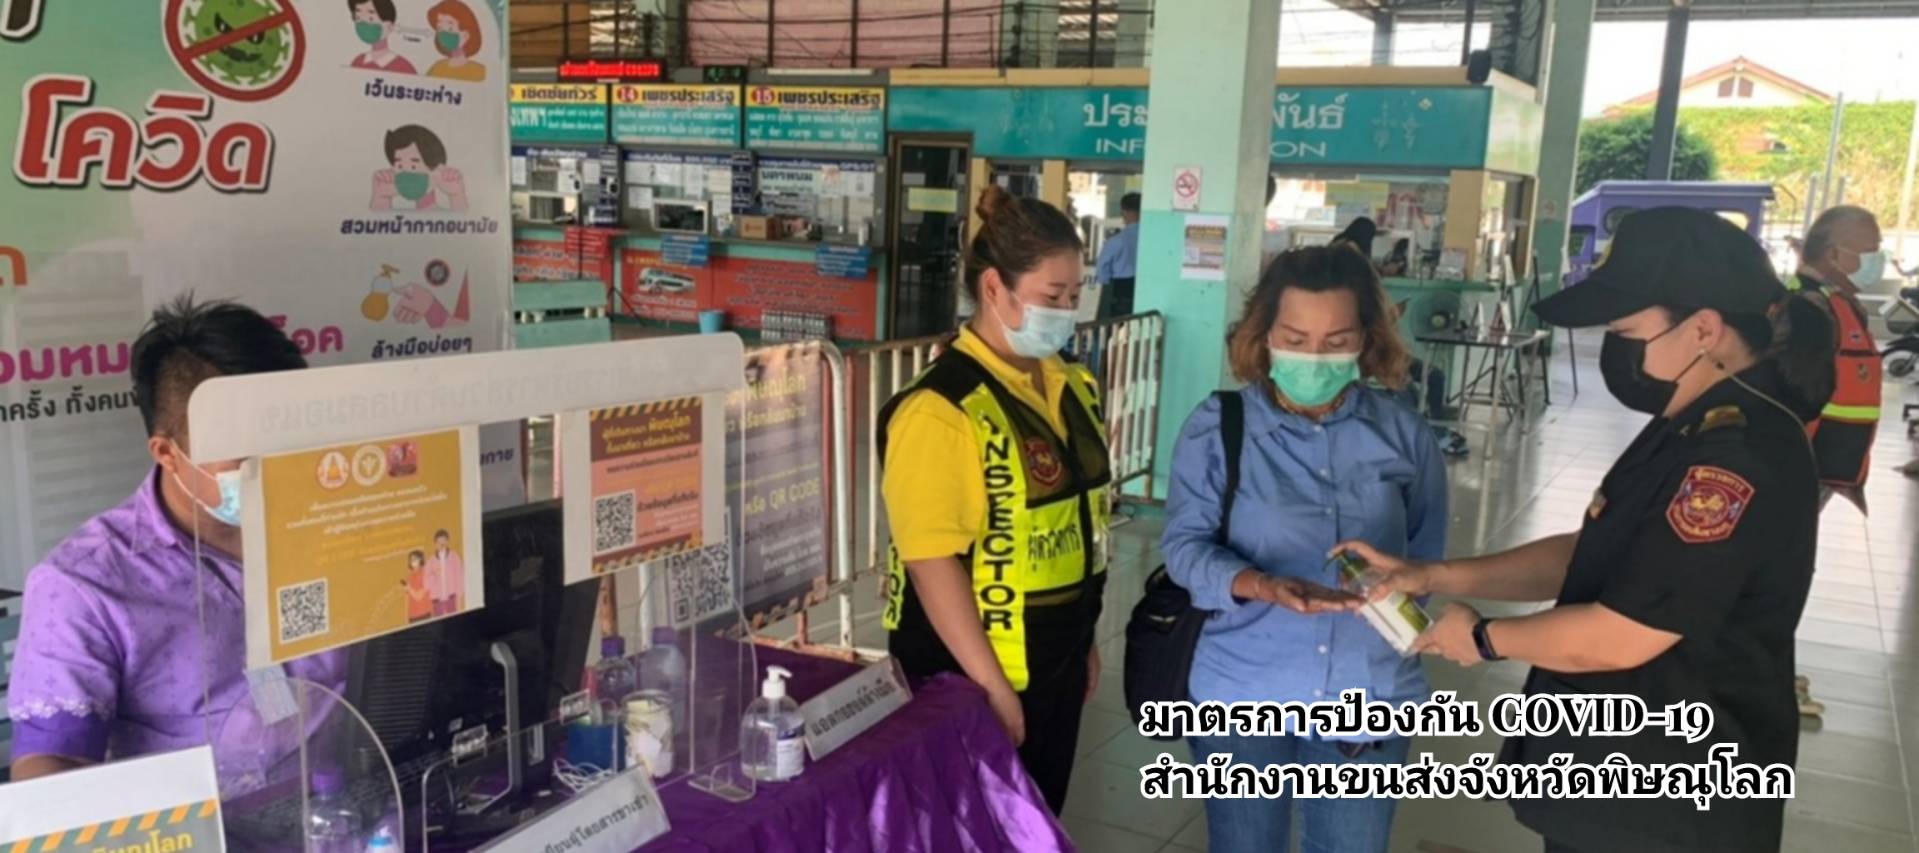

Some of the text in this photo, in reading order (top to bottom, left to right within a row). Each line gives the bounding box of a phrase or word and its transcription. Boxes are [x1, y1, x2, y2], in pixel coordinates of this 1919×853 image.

[364, 78, 462, 105] เว้นระยะห่าง
[16, 76, 274, 191] โควิด
[340, 216, 498, 235] สวมหน้ากากอนามัย
[371, 334, 473, 360] ล้างมือบ่อยๆ
